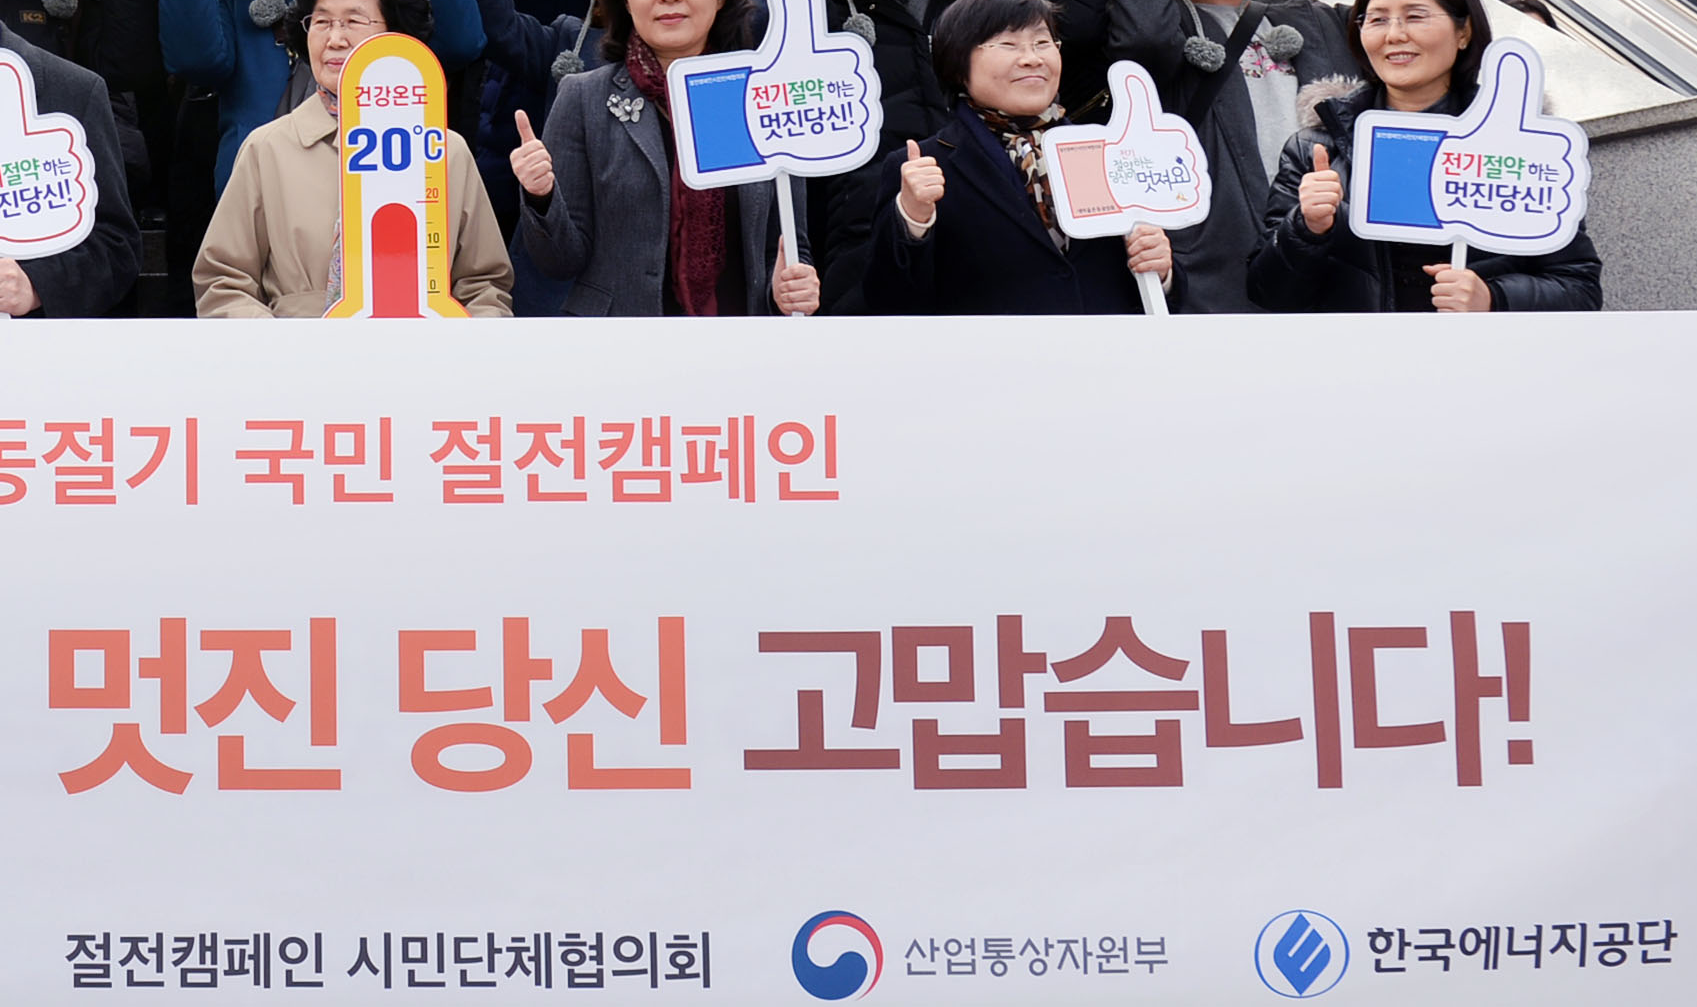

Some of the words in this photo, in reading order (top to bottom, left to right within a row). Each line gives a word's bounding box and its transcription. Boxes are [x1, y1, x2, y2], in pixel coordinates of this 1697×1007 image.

[354, 85, 429, 107] 건강온도
[752, 77, 825, 110] 전기절약
[827, 80, 855, 98] 하는
[759, 101, 855, 141] 멋진당신!
[42, 157, 72, 177] 하는
[1441, 151, 1526, 181] 전기절약
[1528, 163, 1560, 183] 하는
[425, 188, 439, 199] 20
[1445, 180, 1553, 214] 멋진당신!
[427, 232, 440, 243] 10
[429, 279, 437, 290] 0
[236, 417, 393, 505] 국민
[430, 415, 839, 503] 절전캠페인
[49, 618, 341, 795] 멋진
[399, 617, 692, 792] 당신
[744, 611, 1533, 790] 고맙습니다!
[65, 932, 324, 989] 절전캠페인
[347, 932, 711, 990] 시민단체협의회
[904, 936, 1169, 978] 산업통상자원부
[1367, 919, 1679, 973] 한국에너지공단
